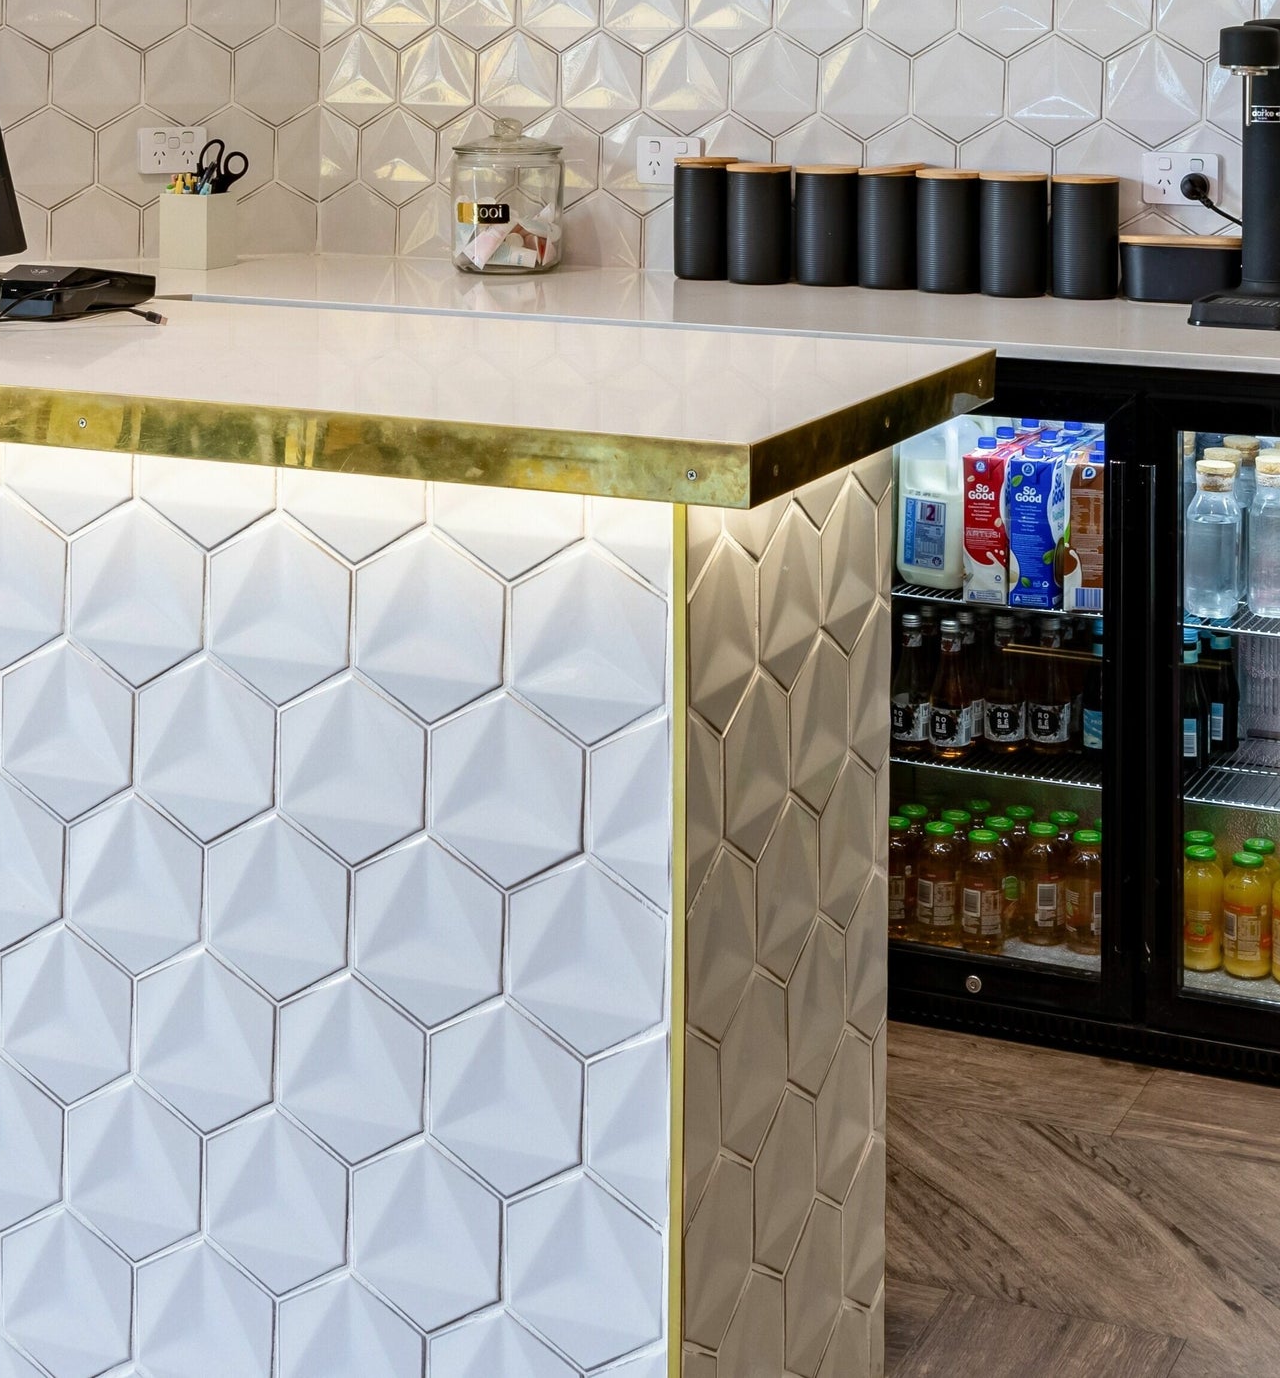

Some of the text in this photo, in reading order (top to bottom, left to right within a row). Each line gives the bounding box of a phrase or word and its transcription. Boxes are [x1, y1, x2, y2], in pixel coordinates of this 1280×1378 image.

[975, 483, 989, 493] So
[1022, 486, 1037, 495] So
[968, 491, 995, 501] Good
[1015, 493, 1042, 503] Good
[925, 504, 936, 521] 2
